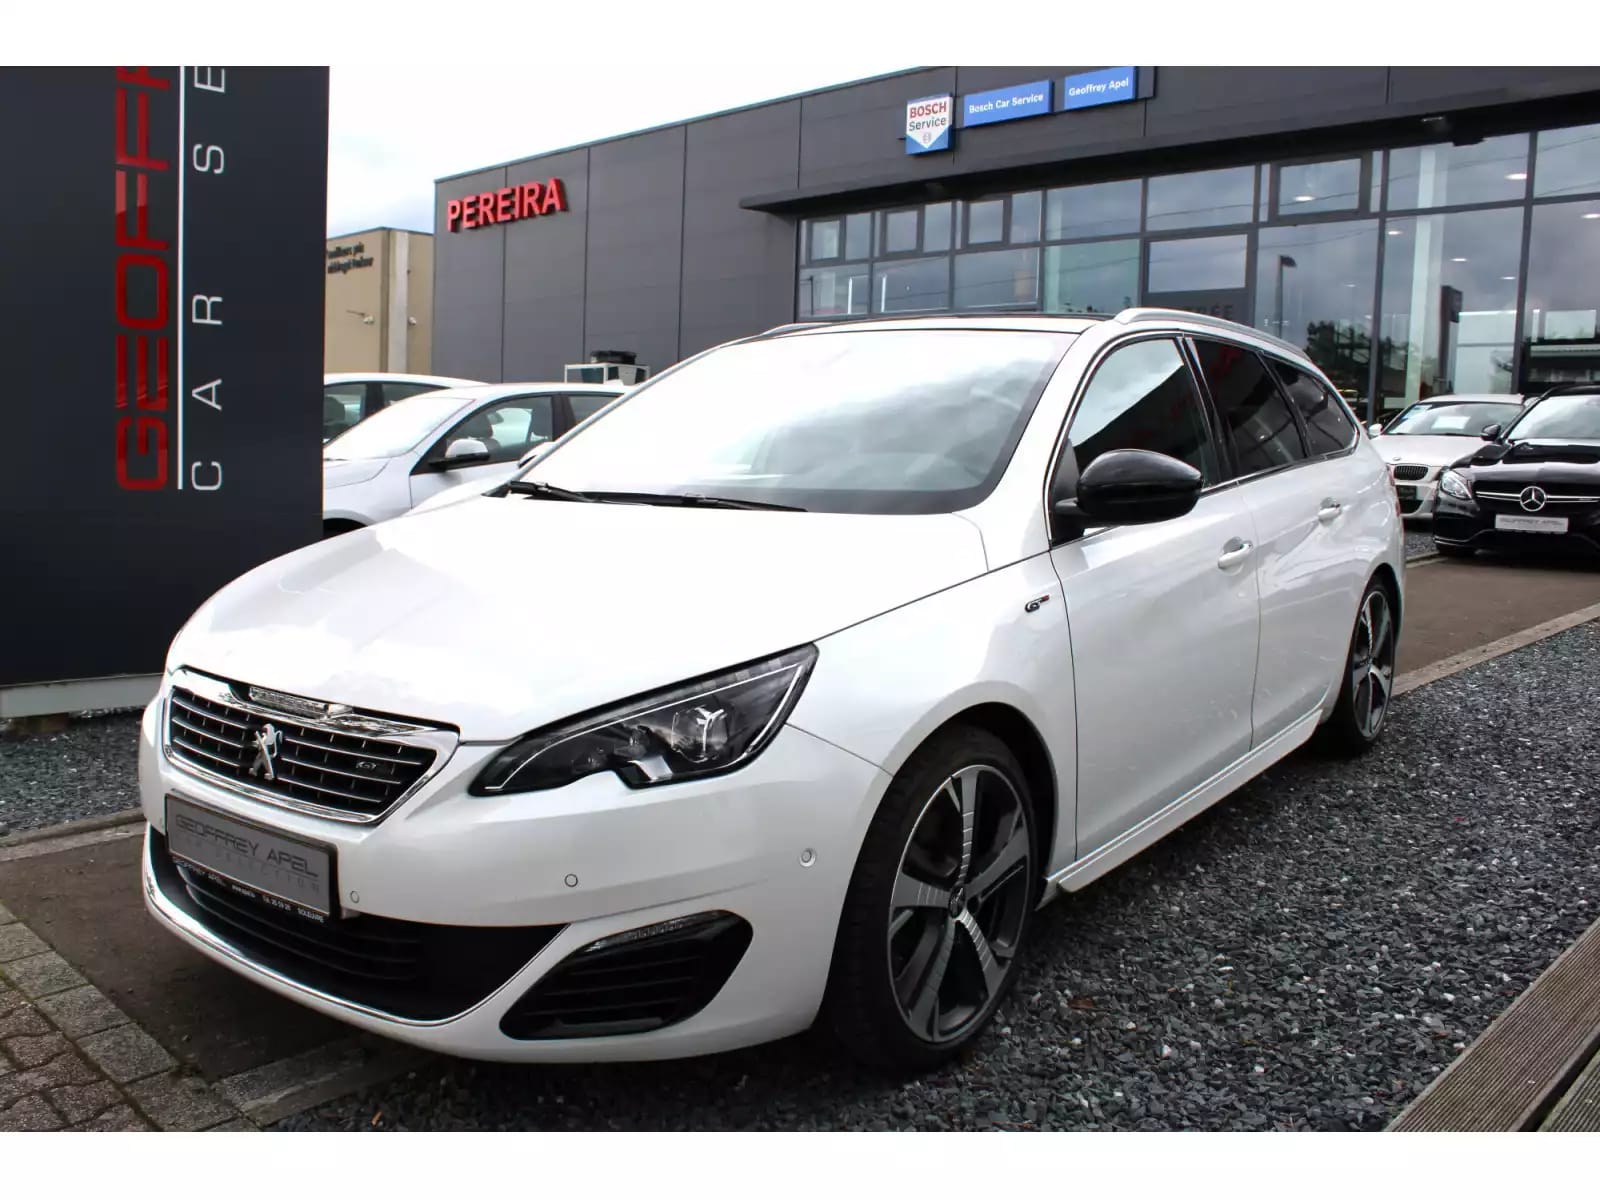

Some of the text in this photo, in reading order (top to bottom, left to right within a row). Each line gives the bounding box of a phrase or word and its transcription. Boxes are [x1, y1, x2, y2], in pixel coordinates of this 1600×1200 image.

[1069, 77, 1129, 97] Geoffrey Apel
[909, 101, 947, 119] BOSCH
[968, 93, 1044, 114] Bosch Car Service
[908, 117, 947, 132] Service
[447, 177, 567, 232] PEREIRA
[176, 815, 259, 857] GEOFFREY
[266, 848, 319, 878] APEL
